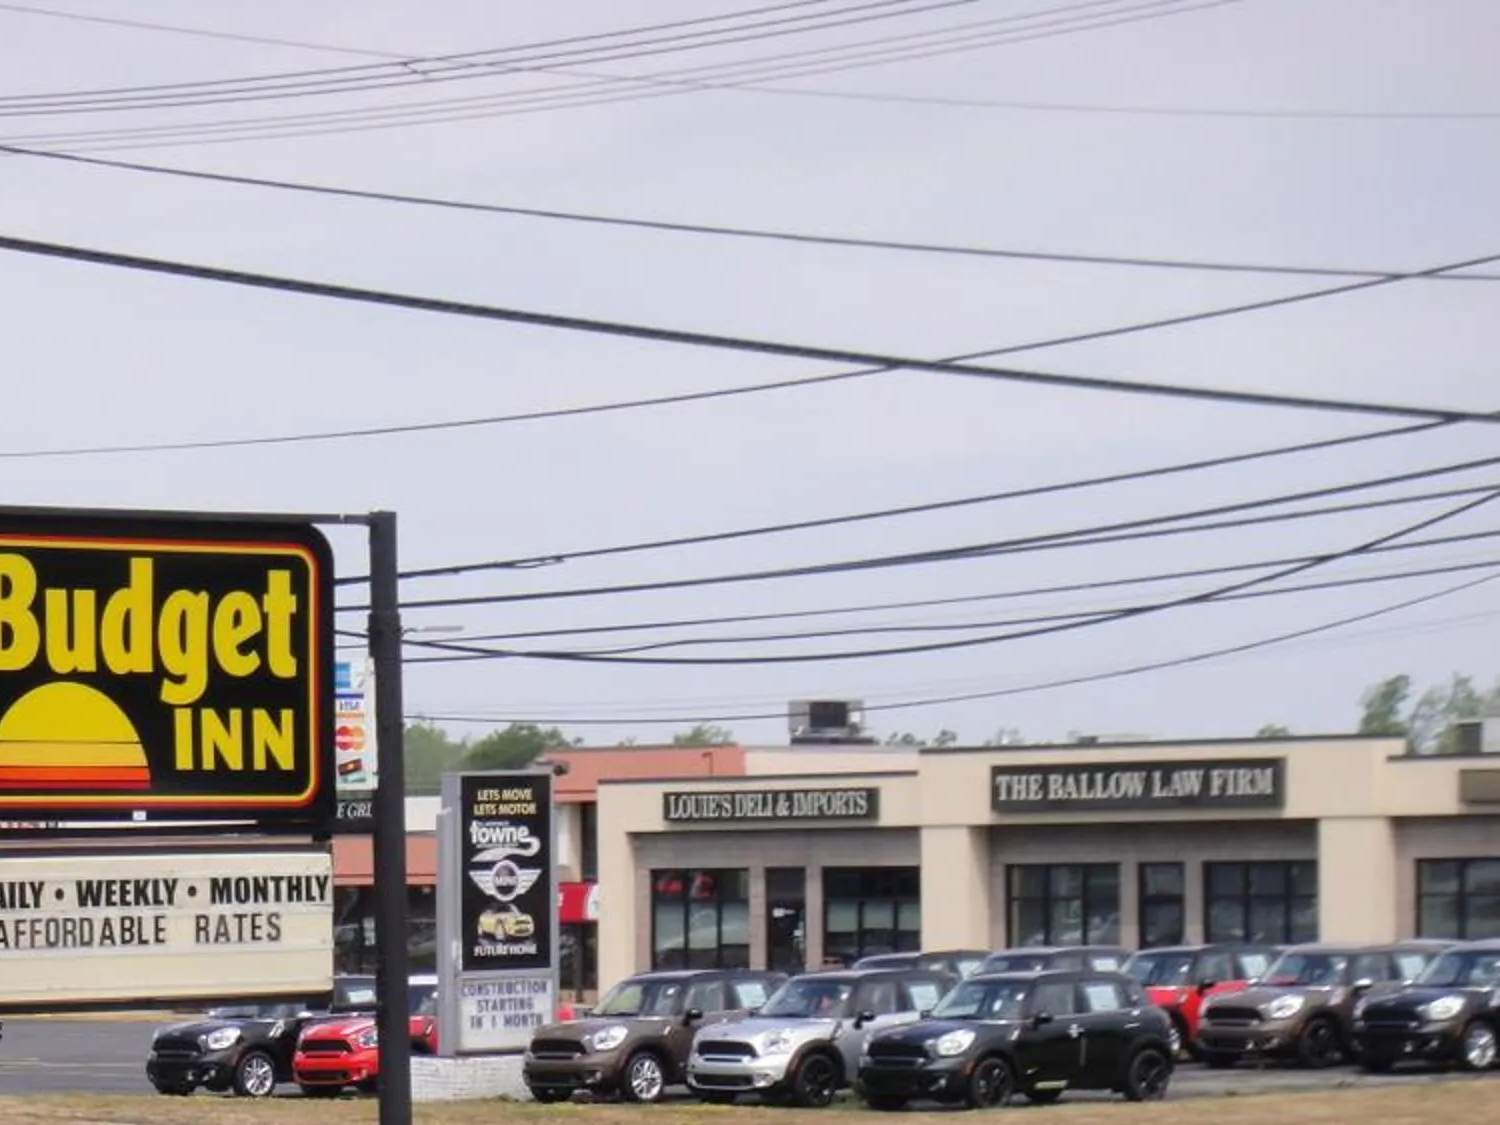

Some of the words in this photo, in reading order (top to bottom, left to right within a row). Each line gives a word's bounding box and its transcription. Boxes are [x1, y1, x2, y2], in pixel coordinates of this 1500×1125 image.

[174, 707, 295, 771] INN
[477, 789, 500, 801] LETS
[502, 787, 532, 801] MOVE
[996, 775, 1043, 801] THE
[1049, 772, 1147, 800] BALLOW
[1151, 769, 1204, 798] LAW
[1209, 767, 1274, 797] FIRM
[473, 803, 497, 816] LETS
[498, 802, 537, 816] MOTOR
[668, 794, 733, 819] LOUIE'S
[734, 793, 773, 818] DELI
[775, 793, 791, 817] &
[792, 791, 868, 817] IMPORTS
[76, 878, 178, 908] WEEKLY
[210, 875, 329, 905] MONTHLY
[195, 913, 282, 944] RATES
[462, 981, 547, 996] CONSTRUCTION
[477, 998, 534, 1012] STARTING
